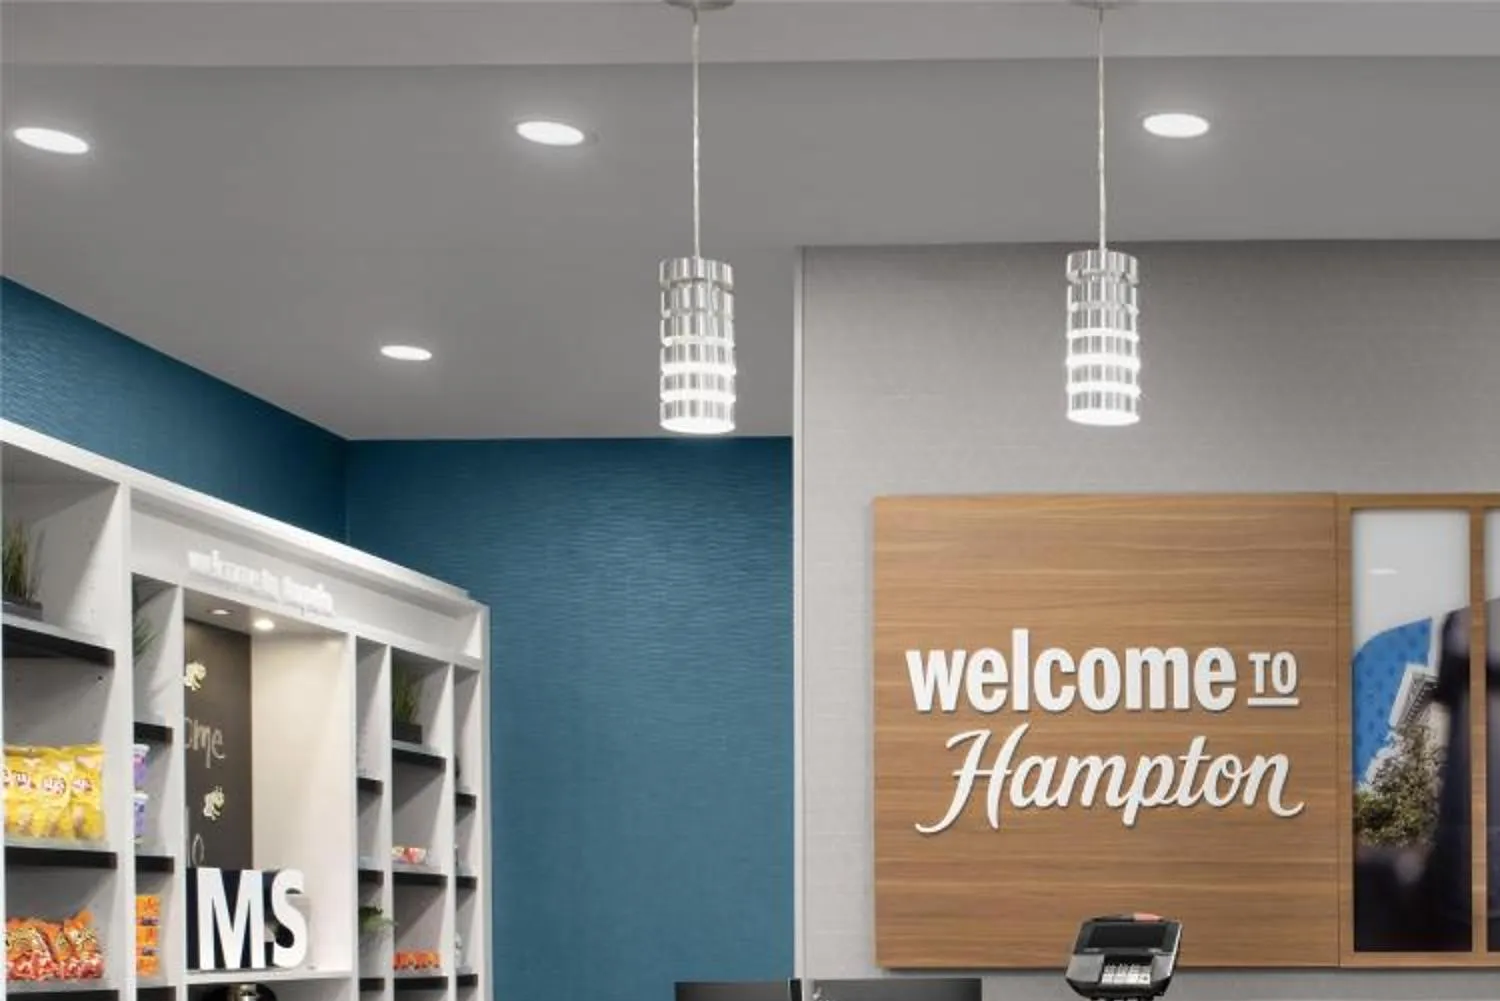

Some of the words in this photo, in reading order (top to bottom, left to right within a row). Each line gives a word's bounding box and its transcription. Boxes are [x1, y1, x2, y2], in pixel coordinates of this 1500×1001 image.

[905, 628, 1237, 712] welcome
[1248, 651, 1298, 697] TO
[915, 722, 1303, 833] Hampton
[197, 867, 308, 970] MS
